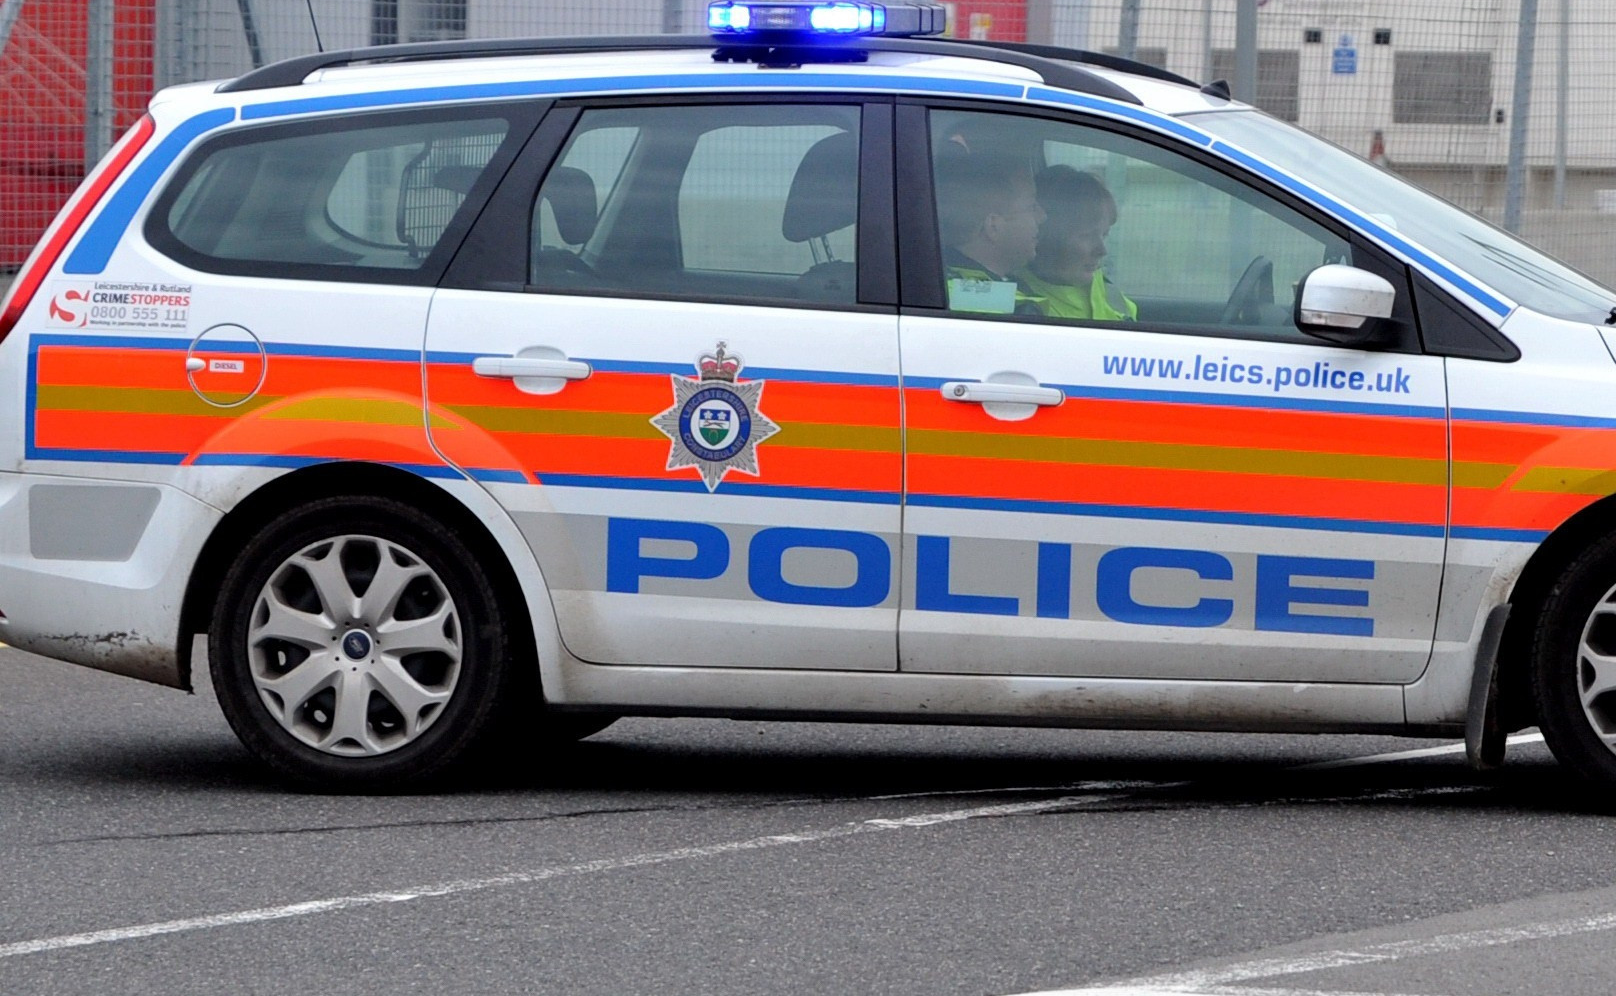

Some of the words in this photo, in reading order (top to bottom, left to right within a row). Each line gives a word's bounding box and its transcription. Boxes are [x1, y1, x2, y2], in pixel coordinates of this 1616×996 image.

[94, 282, 150, 292] Leicestershire
[160, 284, 192, 293] Rutland
[92, 292, 190, 307] CRIMESTOPPERS
[91, 305, 127, 319] 0800
[132, 307, 158, 320] 555
[164, 309, 187, 321] 111
[1103, 354, 1410, 394] www.leics.police.uk
[606, 516, 1375, 637] POLICE
